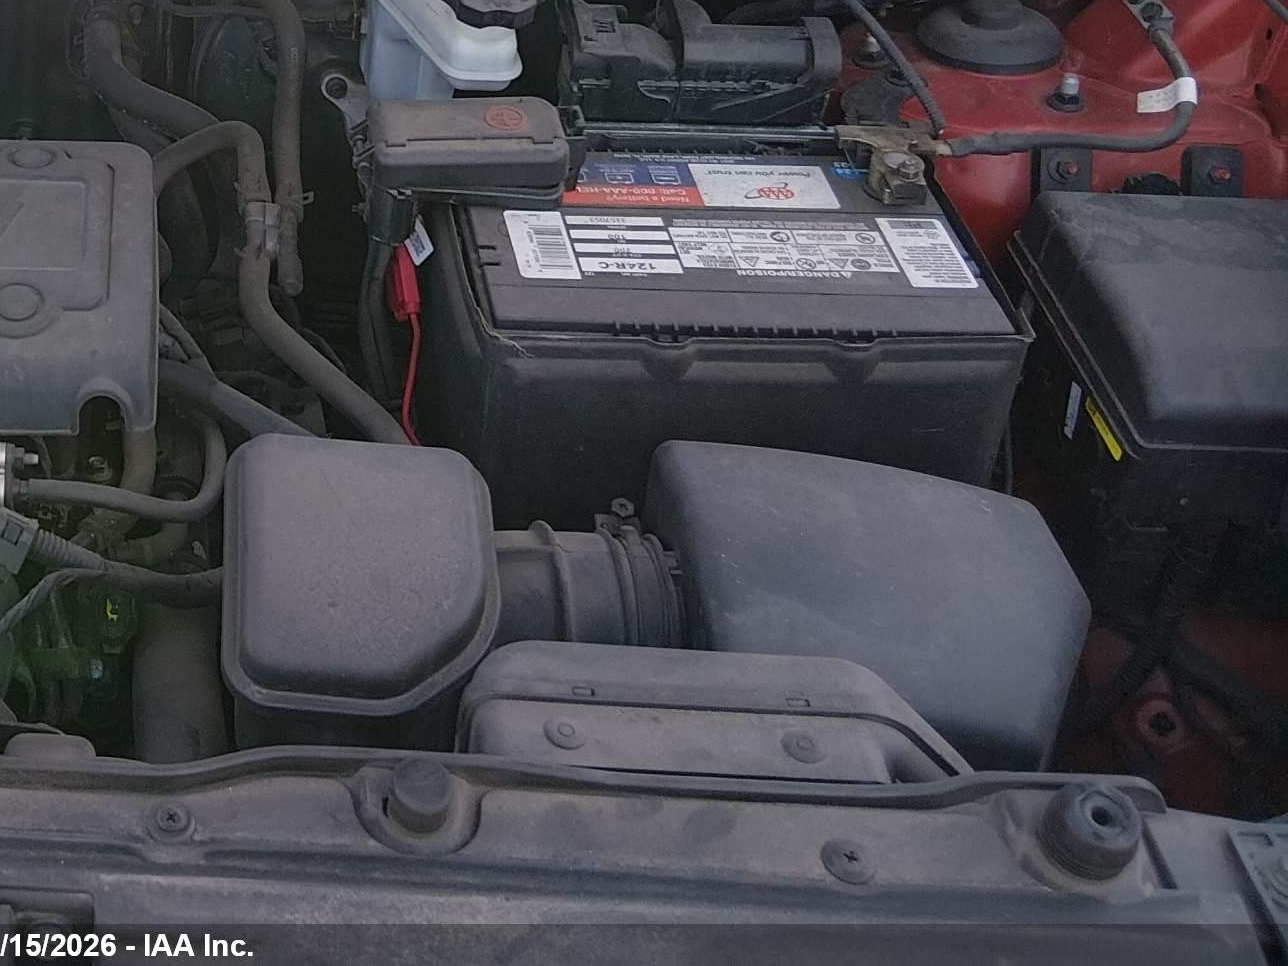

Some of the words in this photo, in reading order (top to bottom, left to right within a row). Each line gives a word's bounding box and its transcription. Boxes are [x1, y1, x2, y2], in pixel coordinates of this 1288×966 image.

[755, 170, 776, 178] you
[759, 186, 794, 200] AAA
[598, 261, 656, 270] 124R-C
[736, 269, 841, 278] DANGER/POISON
